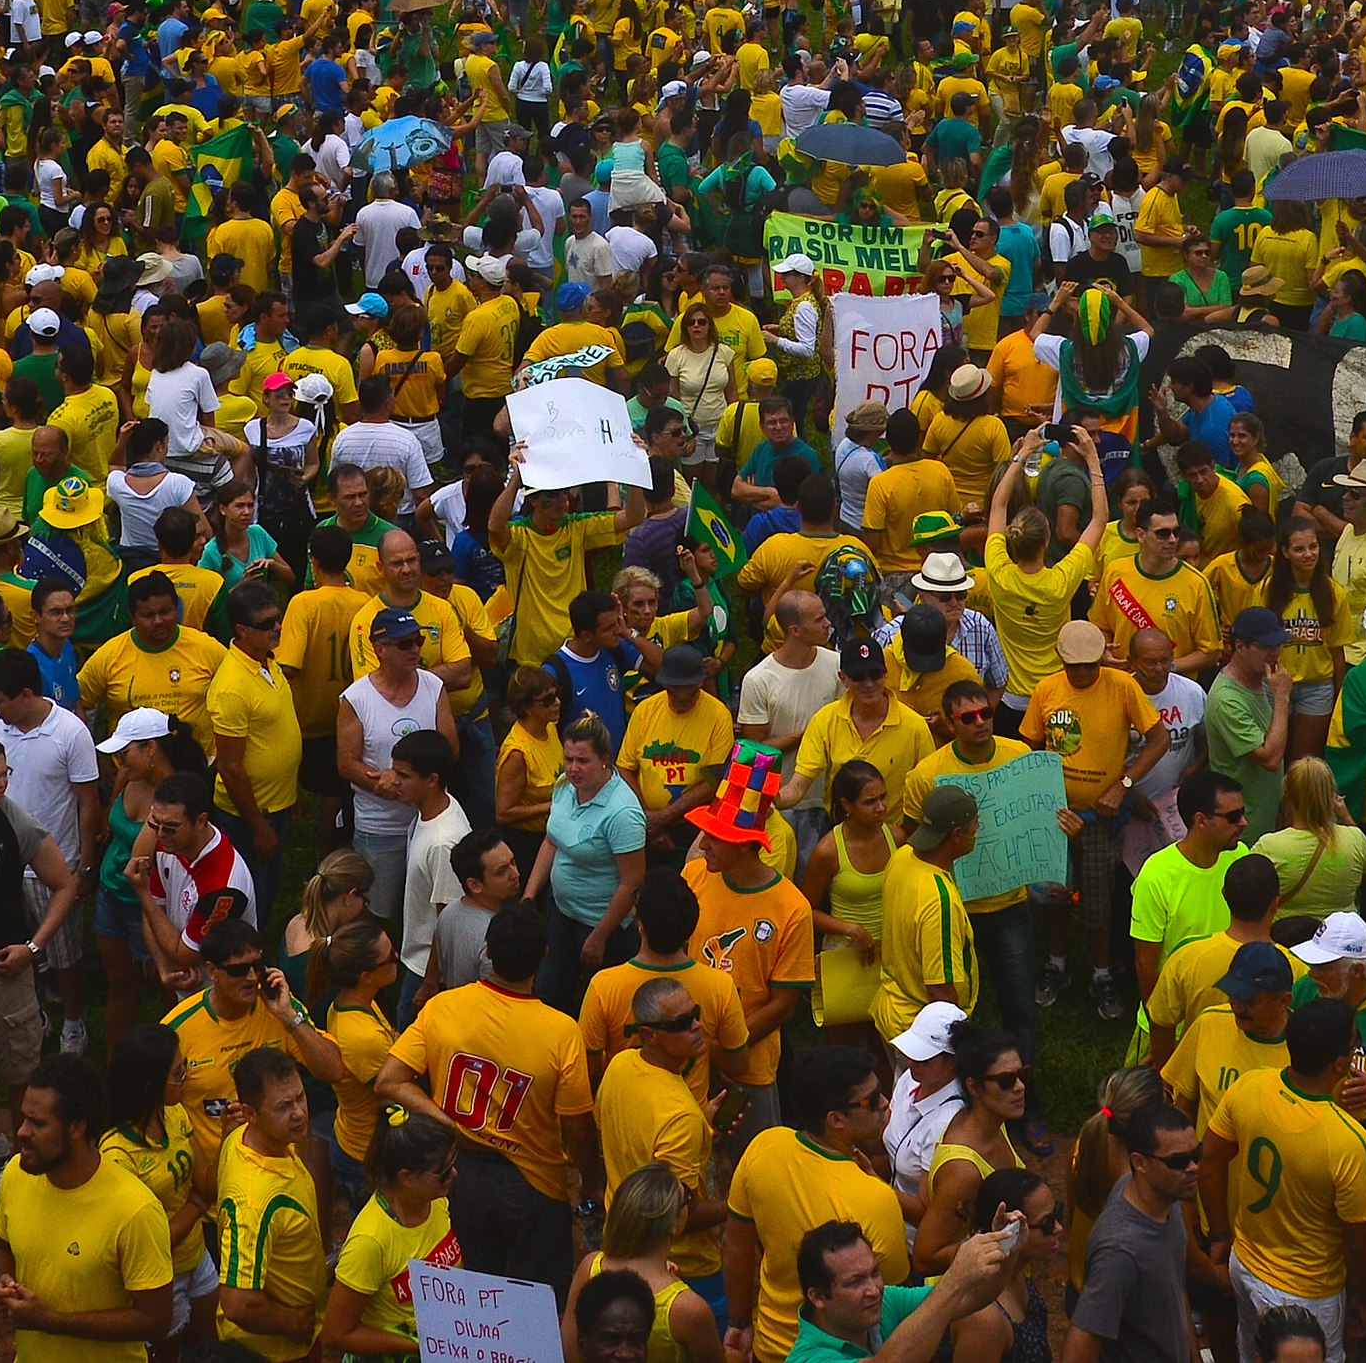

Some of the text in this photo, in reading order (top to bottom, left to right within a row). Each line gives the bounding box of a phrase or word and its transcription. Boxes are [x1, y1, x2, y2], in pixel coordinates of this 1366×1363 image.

[861, 226, 904, 246] UM
[851, 328, 940, 371] FORA
[1113, 589, 1133, 612] CULPA
[1131, 611, 1148, 630] DAS
[1050, 710, 1073, 725] SOU
[665, 766, 686, 783] PT
[442, 1052, 533, 1133] 01
[167, 1149, 192, 1195] 10
[1247, 1135, 1283, 1215] 9
[419, 1274, 466, 1308] FORA
[425, 1335, 470, 1358] DEIXA
[477, 1347, 484, 1362] O
